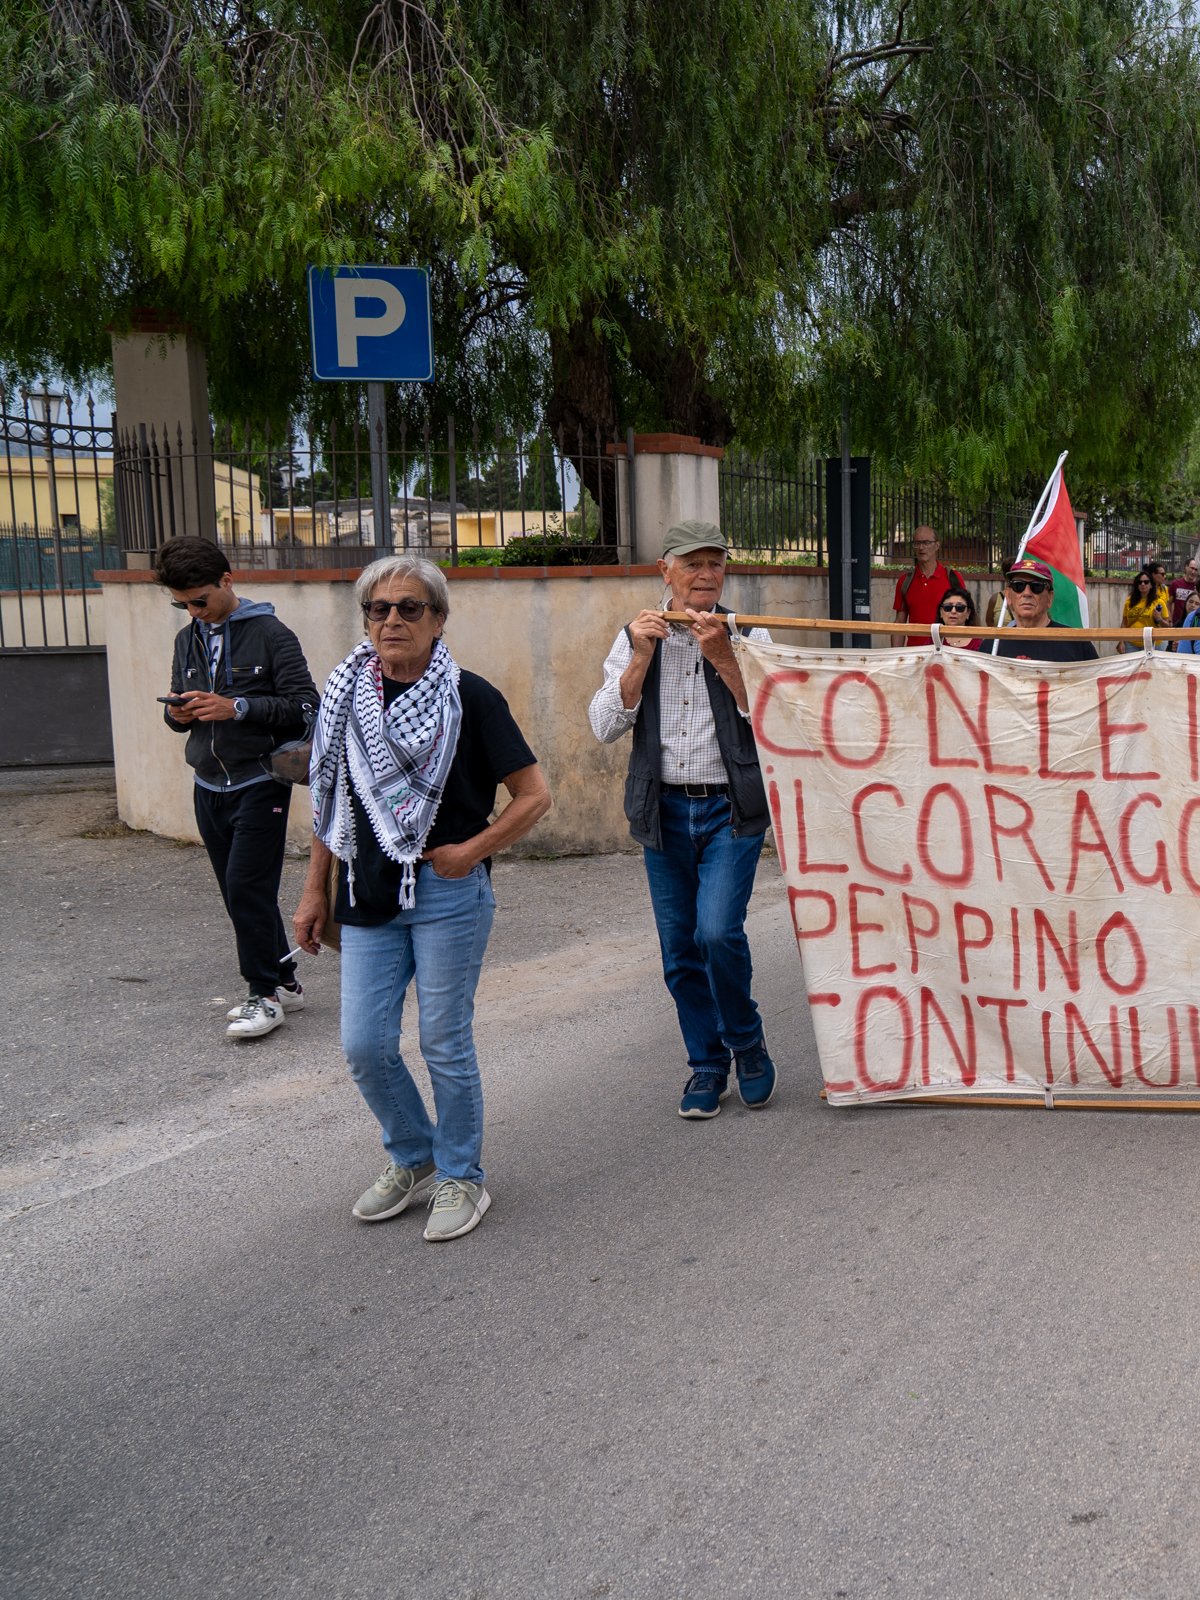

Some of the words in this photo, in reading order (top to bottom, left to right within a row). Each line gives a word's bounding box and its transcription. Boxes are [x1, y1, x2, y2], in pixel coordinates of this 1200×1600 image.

[334, 277, 407, 368] P
[752, 663, 1029, 775] CON
[1036, 671, 1161, 780] LE
[787, 883, 1147, 996] PEPPINO
